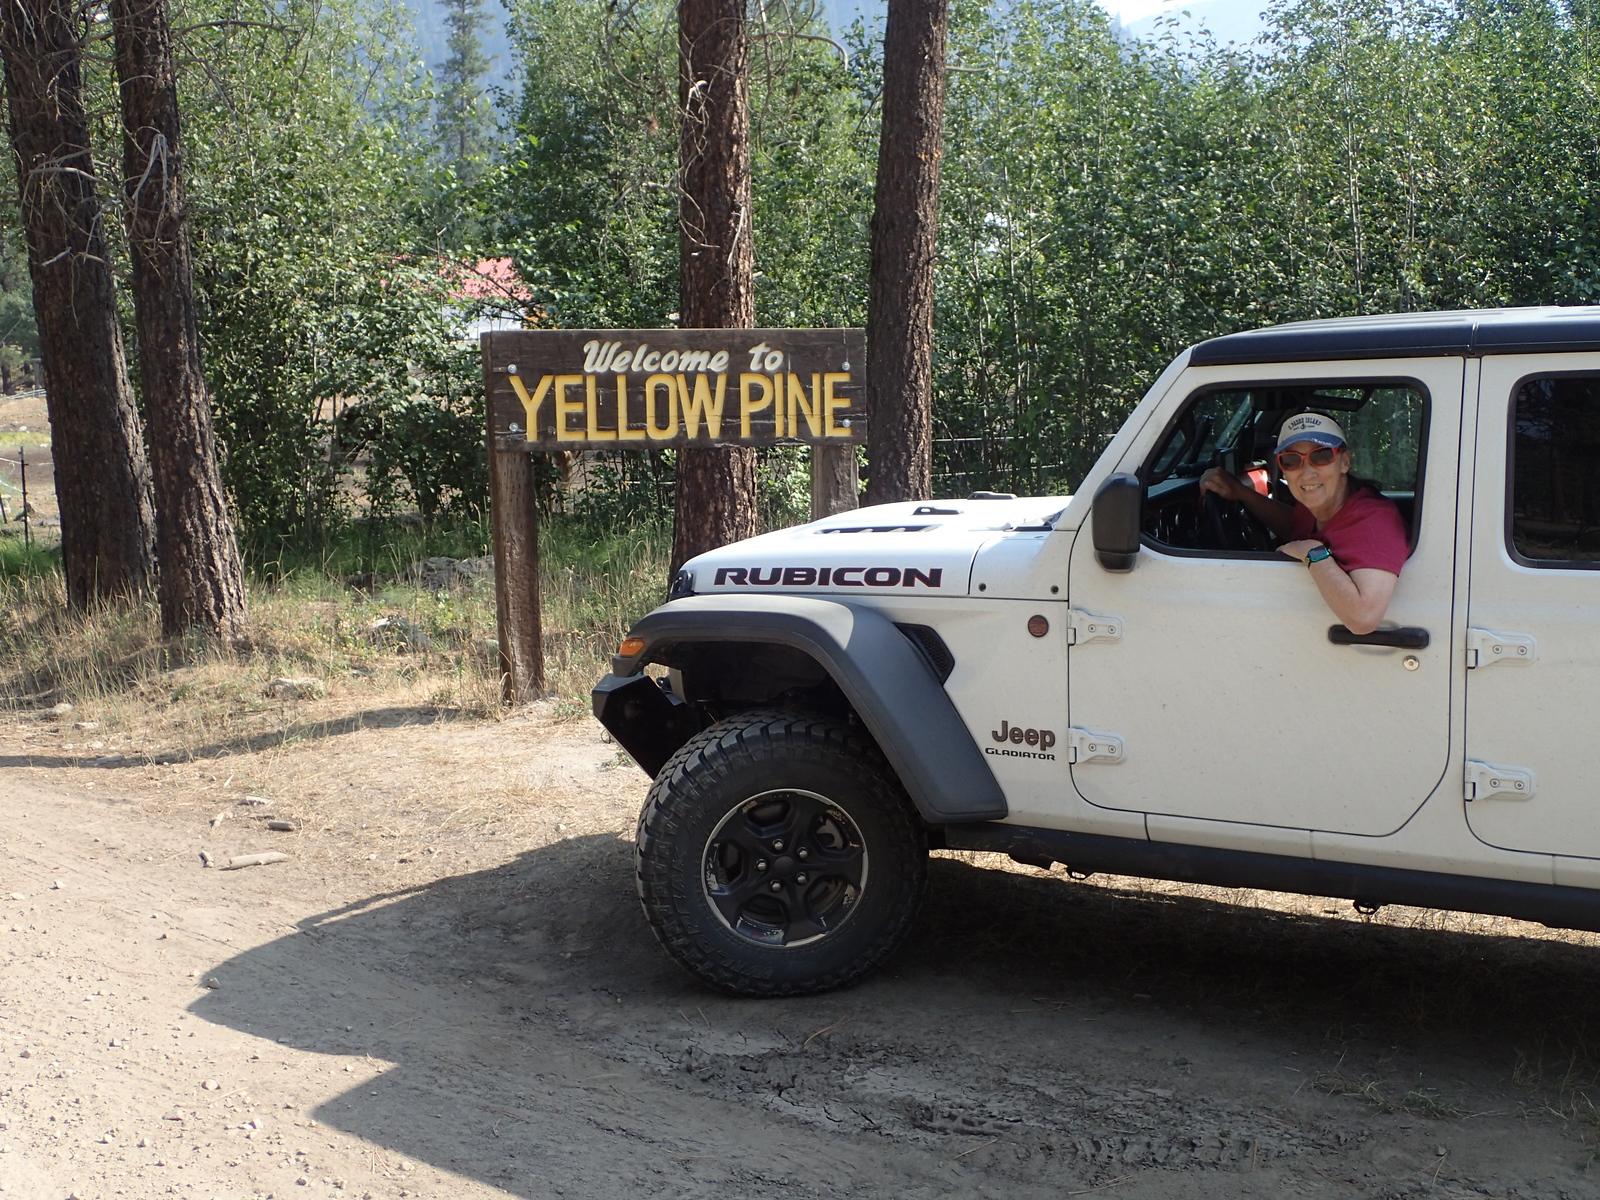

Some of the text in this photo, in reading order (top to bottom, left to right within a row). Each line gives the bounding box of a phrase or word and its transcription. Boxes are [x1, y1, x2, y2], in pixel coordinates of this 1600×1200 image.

[583, 339, 784, 373] Welcome to
[508, 372, 853, 442] YELLOW PINE
[713, 567, 943, 588] RUBICON
[991, 720, 1056, 751] Jeep
[985, 747, 1056, 761] GLADIATOR
